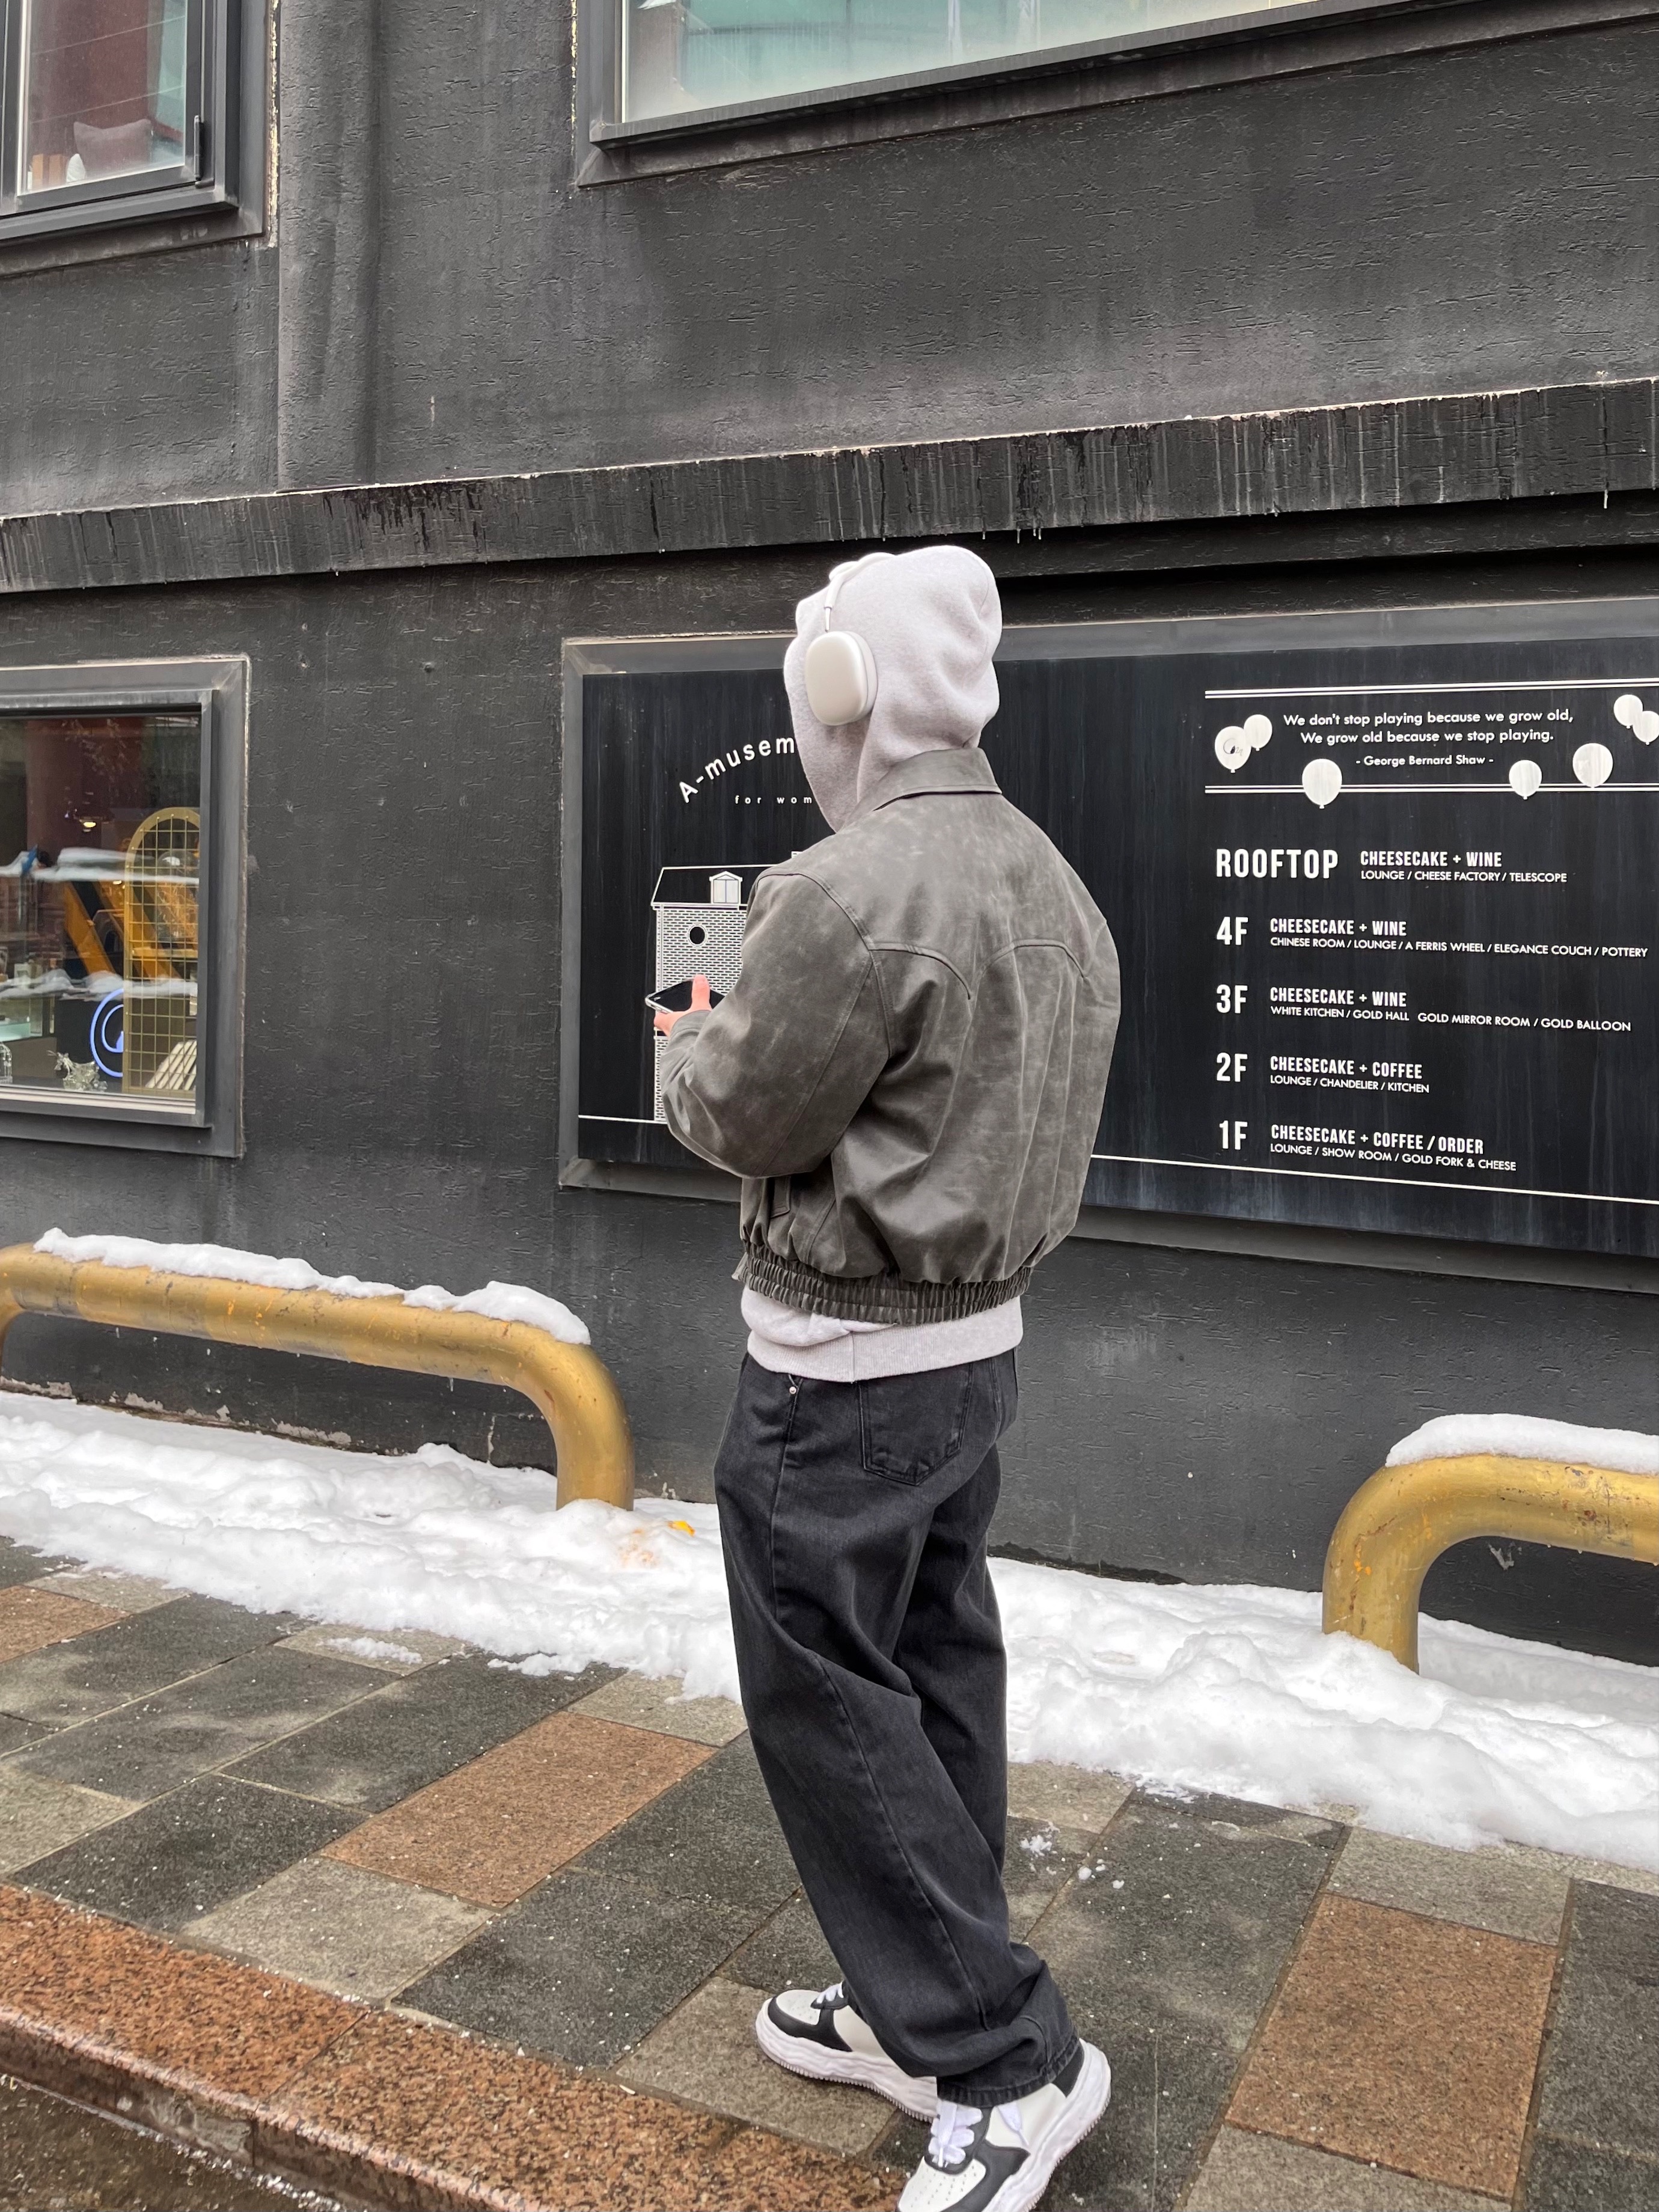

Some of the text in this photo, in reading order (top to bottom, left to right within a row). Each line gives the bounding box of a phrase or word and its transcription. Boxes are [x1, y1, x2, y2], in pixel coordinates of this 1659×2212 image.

[1283, 715, 1305, 726] We
[1309, 713, 1340, 725] don't
[1344, 715, 1370, 727] stop
[1375, 712, 1422, 727] playing
[1428, 712, 1480, 723] because
[1509, 713, 1542, 724] grow
[1547, 709, 1573, 723] old,
[1301, 729, 1553, 746] We grow old because we stop playing.
[679, 738, 795, 803] A-musem
[1364, 756, 1405, 768] George
[1409, 755, 1452, 765] Bernard
[1456, 755, 1485, 765] Shaw
[735, 795, 761, 804] for
[1217, 849, 1337, 878] ROOFTOP
[1361, 851, 1502, 867] CHEESECAKE + WINE
[1361, 870, 1404, 879] LOUNGE
[1414, 871, 1452, 880] CHEESE
[1455, 872, 1500, 881] FACTORY
[1509, 873, 1567, 882] TELESCOPE
[1217, 917, 1248, 945] 4F
[1270, 918, 1407, 936] CHEESECAKE + WINE
[1271, 937, 1310, 947] CHINESE
[1313, 938, 1345, 947] ROOM
[1354, 939, 1396, 949] LOUNGE
[1405, 941, 1413, 950] A
[1416, 941, 1447, 951] FERRIS
[1450, 943, 1485, 952] WHEEL
[1494, 944, 1548, 954] ELEGANCE
[1551, 946, 1592, 955] COUCH
[1602, 947, 1648, 957] POTTERY
[1217, 985, 1247, 1013] 3F
[1270, 987, 1407, 1007] CHEESECAKE + WINE
[1271, 1006, 1301, 1015] WHITE
[1304, 1007, 1344, 1017] KITCHEN
[1353, 1010, 1382, 1019] GOLD
[1386, 1011, 1409, 1021] HALL
[1418, 1013, 1449, 1022] GOLD
[1452, 1015, 1491, 1024] MIRROR
[1495, 1016, 1530, 1026] ROOM
[1541, 1018, 1574, 1028] GOLD
[1577, 1020, 1631, 1031] BALLOON
[1217, 1053, 1247, 1082] 2F
[1271, 1056, 1422, 1079] CHEESECAKE + COFFEE
[1271, 1075, 1311, 1086] LOUNGE
[1320, 1078, 1378, 1090] CHANDELIER
[1388, 1083, 1429, 1093] KITCHEN
[1220, 1120, 1247, 1150] 1F
[1271, 1125, 1355, 1144] CHEESECAKE
[1360, 1134, 1369, 1143] +
[1373, 1132, 1423, 1149] COFFEE
[1438, 1137, 1483, 1154] ORDER
[1271, 1143, 1312, 1155] LOUNGE
[1322, 1147, 1355, 1158] SHOW
[1358, 1150, 1392, 1161] ROOM
[1402, 1153, 1433, 1164] GOLD
[1436, 1156, 1463, 1167] FORK
[1466, 1158, 1475, 1168] &
[1478, 1159, 1516, 1171] CHEESE
